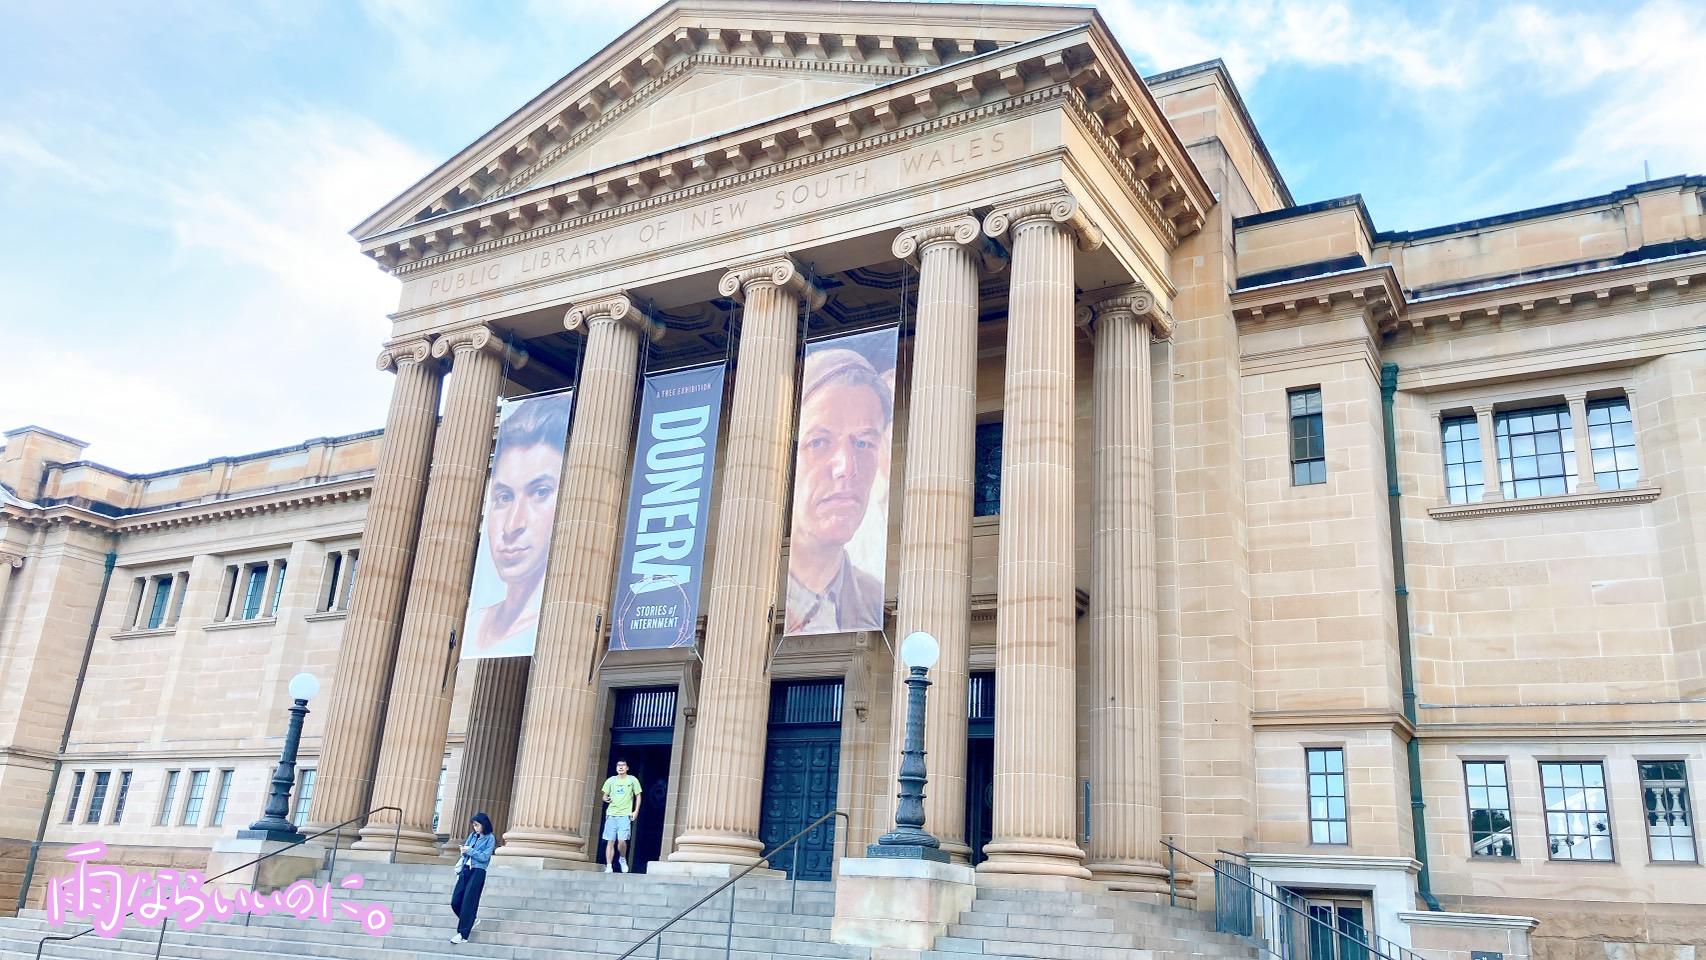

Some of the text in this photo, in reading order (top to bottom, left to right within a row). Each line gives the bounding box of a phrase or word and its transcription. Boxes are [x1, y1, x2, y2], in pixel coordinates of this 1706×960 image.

[429, 131, 1005, 297] PUBLIC LIBRARY OF NEW SOUTH WALES
[661, 388, 676, 398] FREE
[678, 383, 712, 395] EXHIBITION
[629, 404, 711, 595] DUNERA
[636, 604, 677, 617] STORIES of
[630, 616, 679, 630] INTERNMENT
